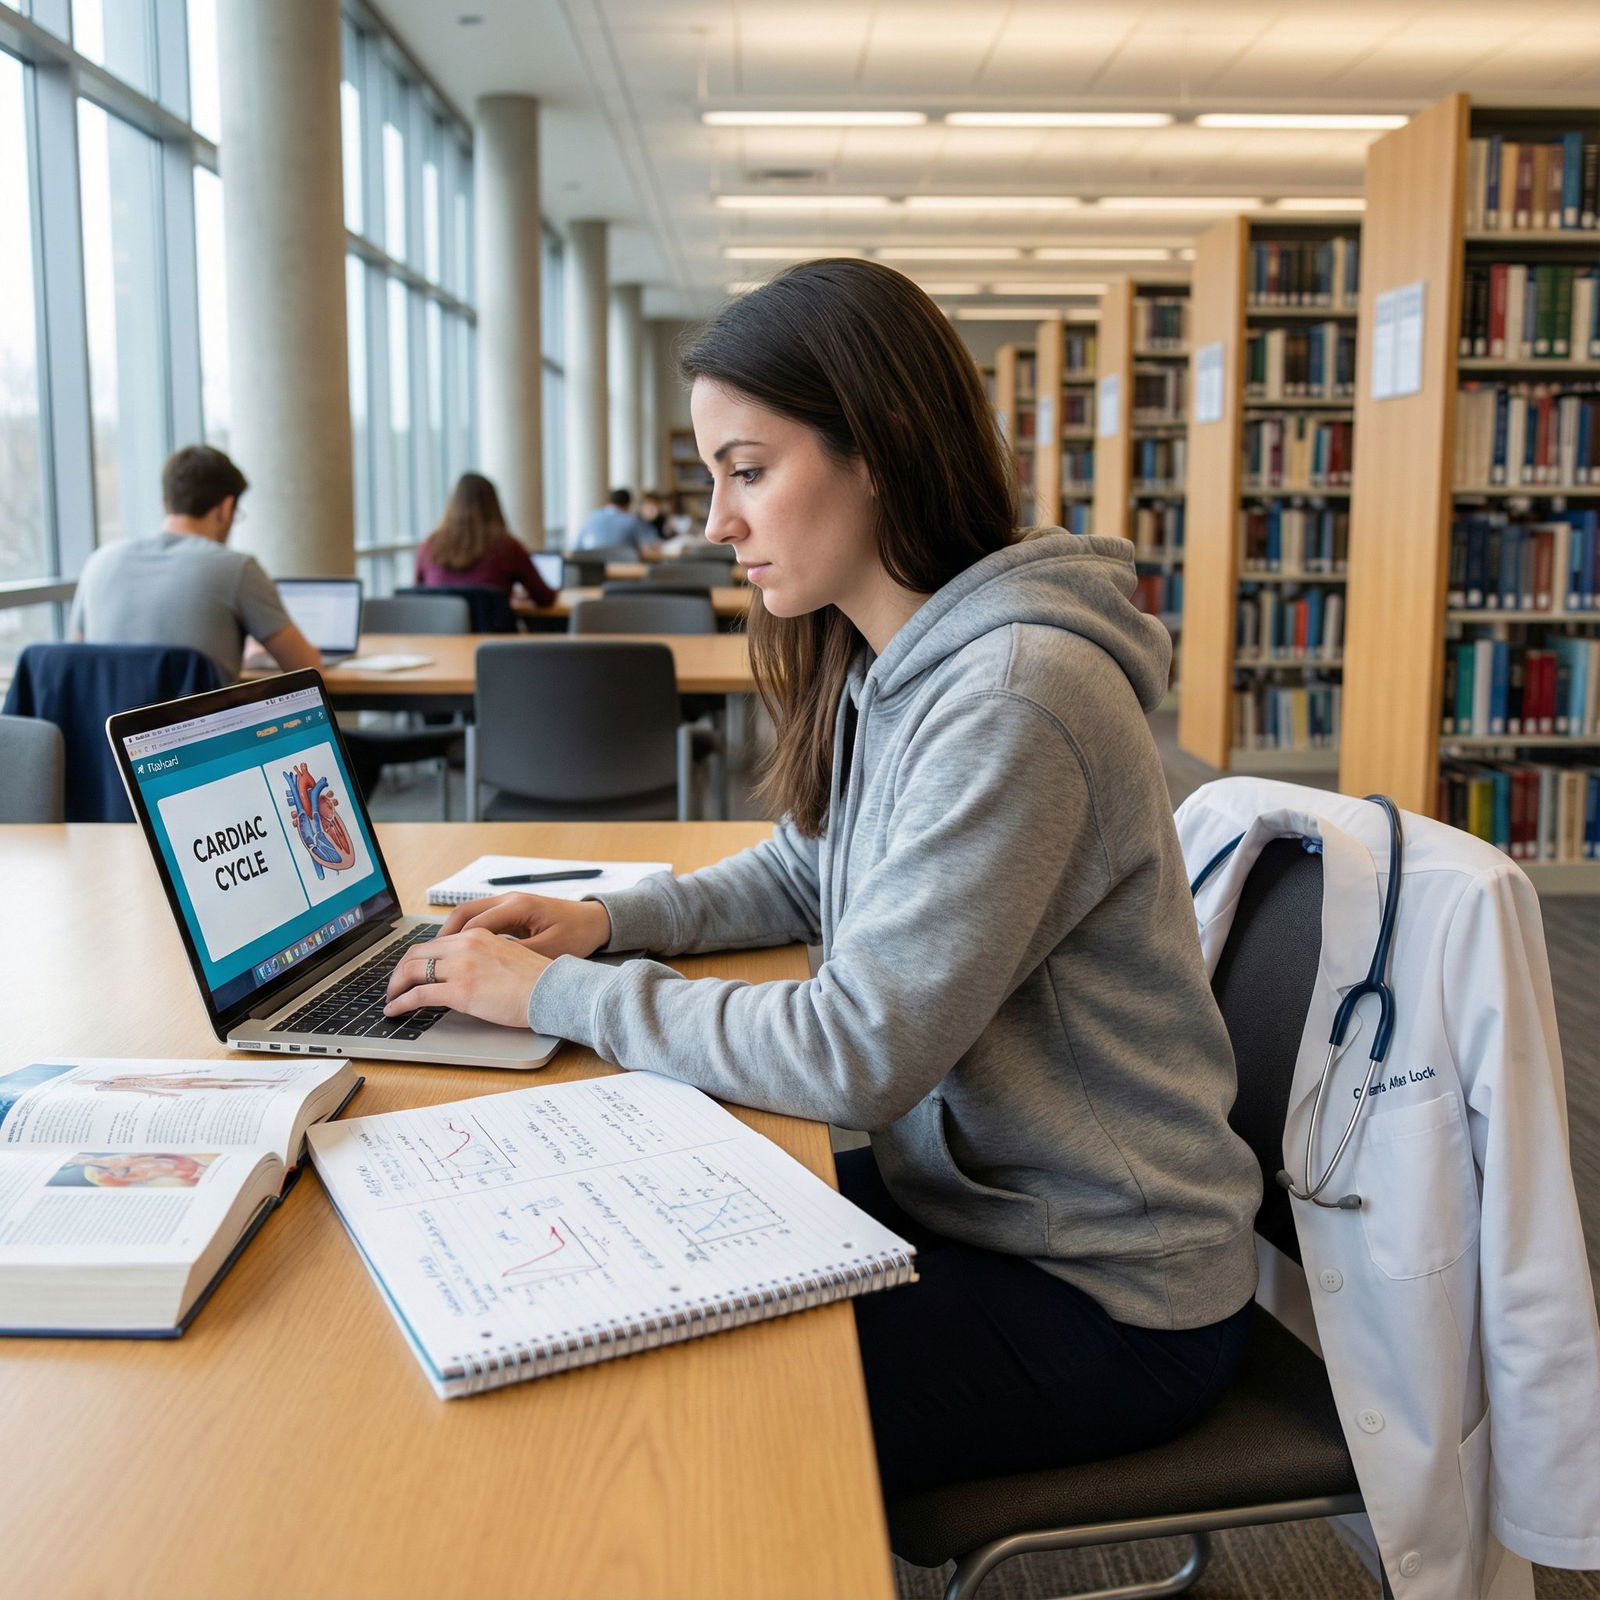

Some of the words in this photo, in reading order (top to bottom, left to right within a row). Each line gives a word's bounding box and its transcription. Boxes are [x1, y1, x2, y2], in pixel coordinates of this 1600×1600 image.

[193, 816, 267, 863] CARDIAC
[215, 850, 269, 891] CYCLE
[1408, 1066, 1436, 1083] Lock
